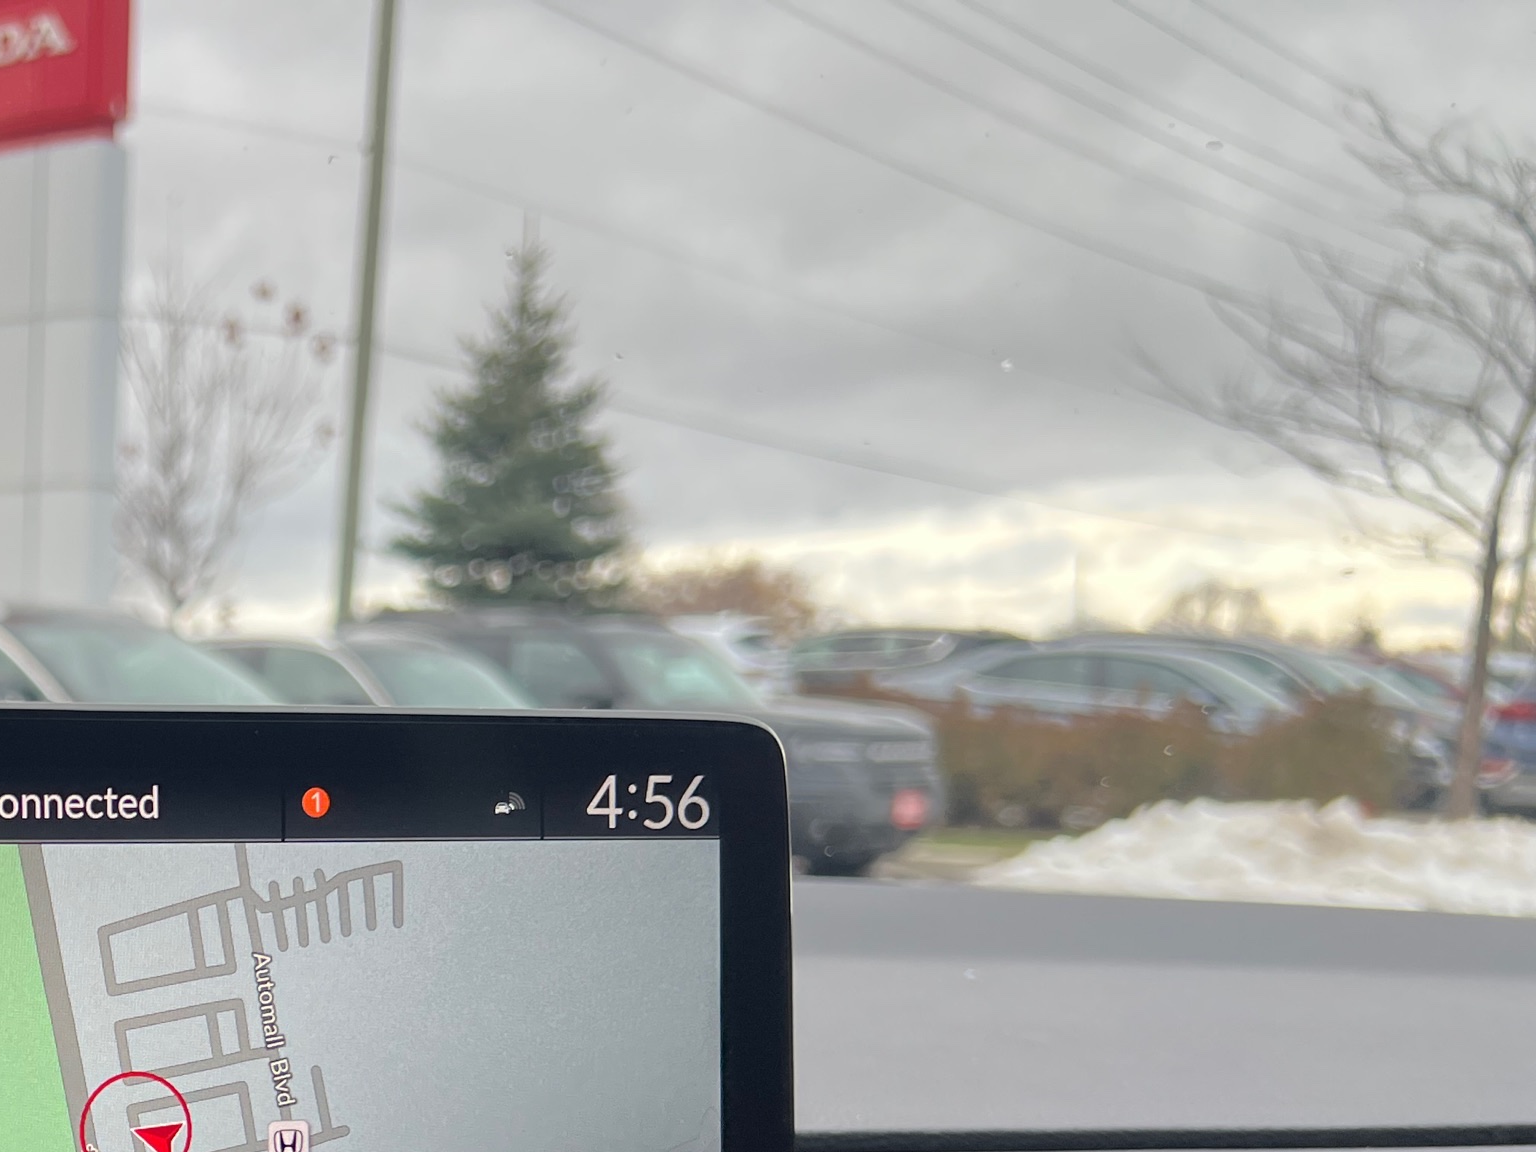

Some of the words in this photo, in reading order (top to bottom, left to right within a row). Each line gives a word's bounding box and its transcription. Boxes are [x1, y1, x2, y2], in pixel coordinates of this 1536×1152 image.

[311, 791, 321, 813] 1
[586, 774, 710, 830] 4:56
[252, 952, 285, 1049] Automall
[270, 1057, 297, 1107] Blvd
